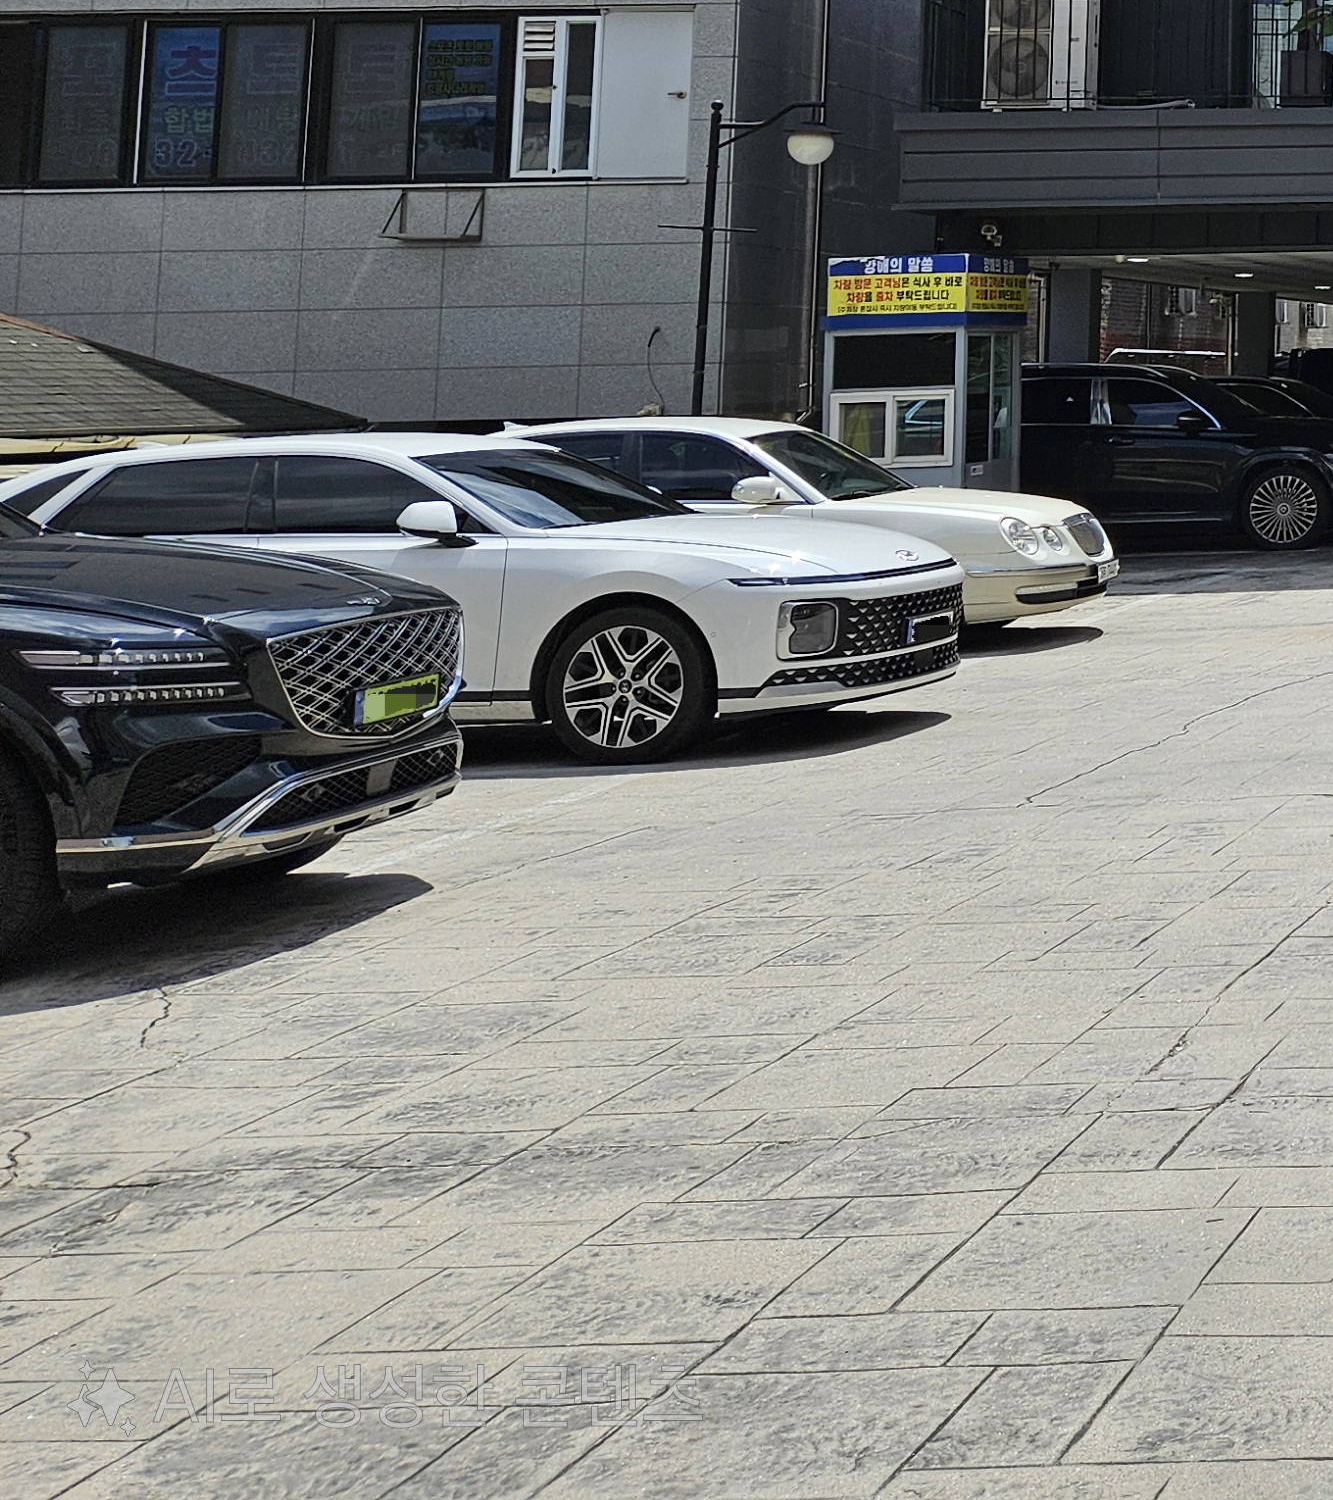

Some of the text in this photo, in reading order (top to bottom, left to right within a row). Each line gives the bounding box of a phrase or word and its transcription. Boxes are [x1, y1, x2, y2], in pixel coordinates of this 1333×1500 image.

[913, 277, 930, 288] 식사
[945, 276, 962, 287] 바로
[896, 290, 950, 301] 부탁드립니다
